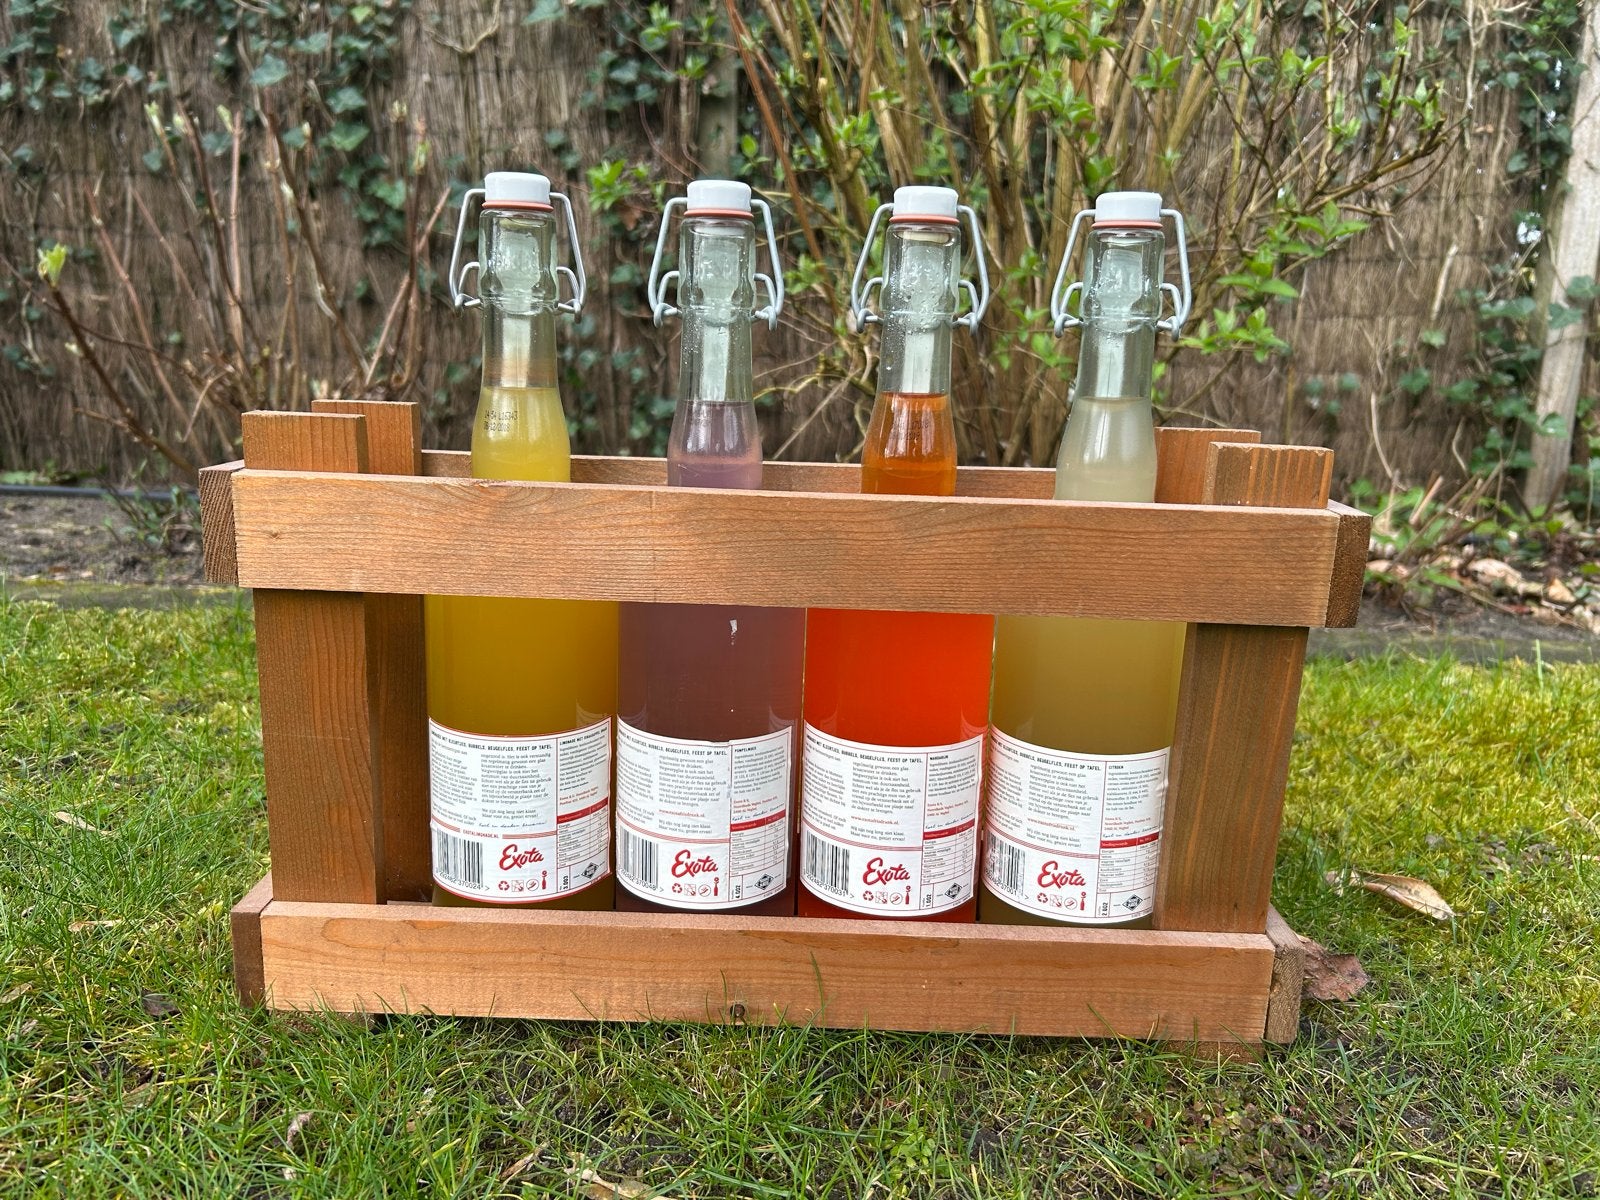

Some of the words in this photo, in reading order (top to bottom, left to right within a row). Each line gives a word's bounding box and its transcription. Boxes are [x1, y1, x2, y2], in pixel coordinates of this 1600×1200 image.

[498, 844, 544, 870] Exota
[671, 849, 718, 878] Exota
[863, 857, 910, 885] Exota
[1037, 860, 1086, 889] Exota
